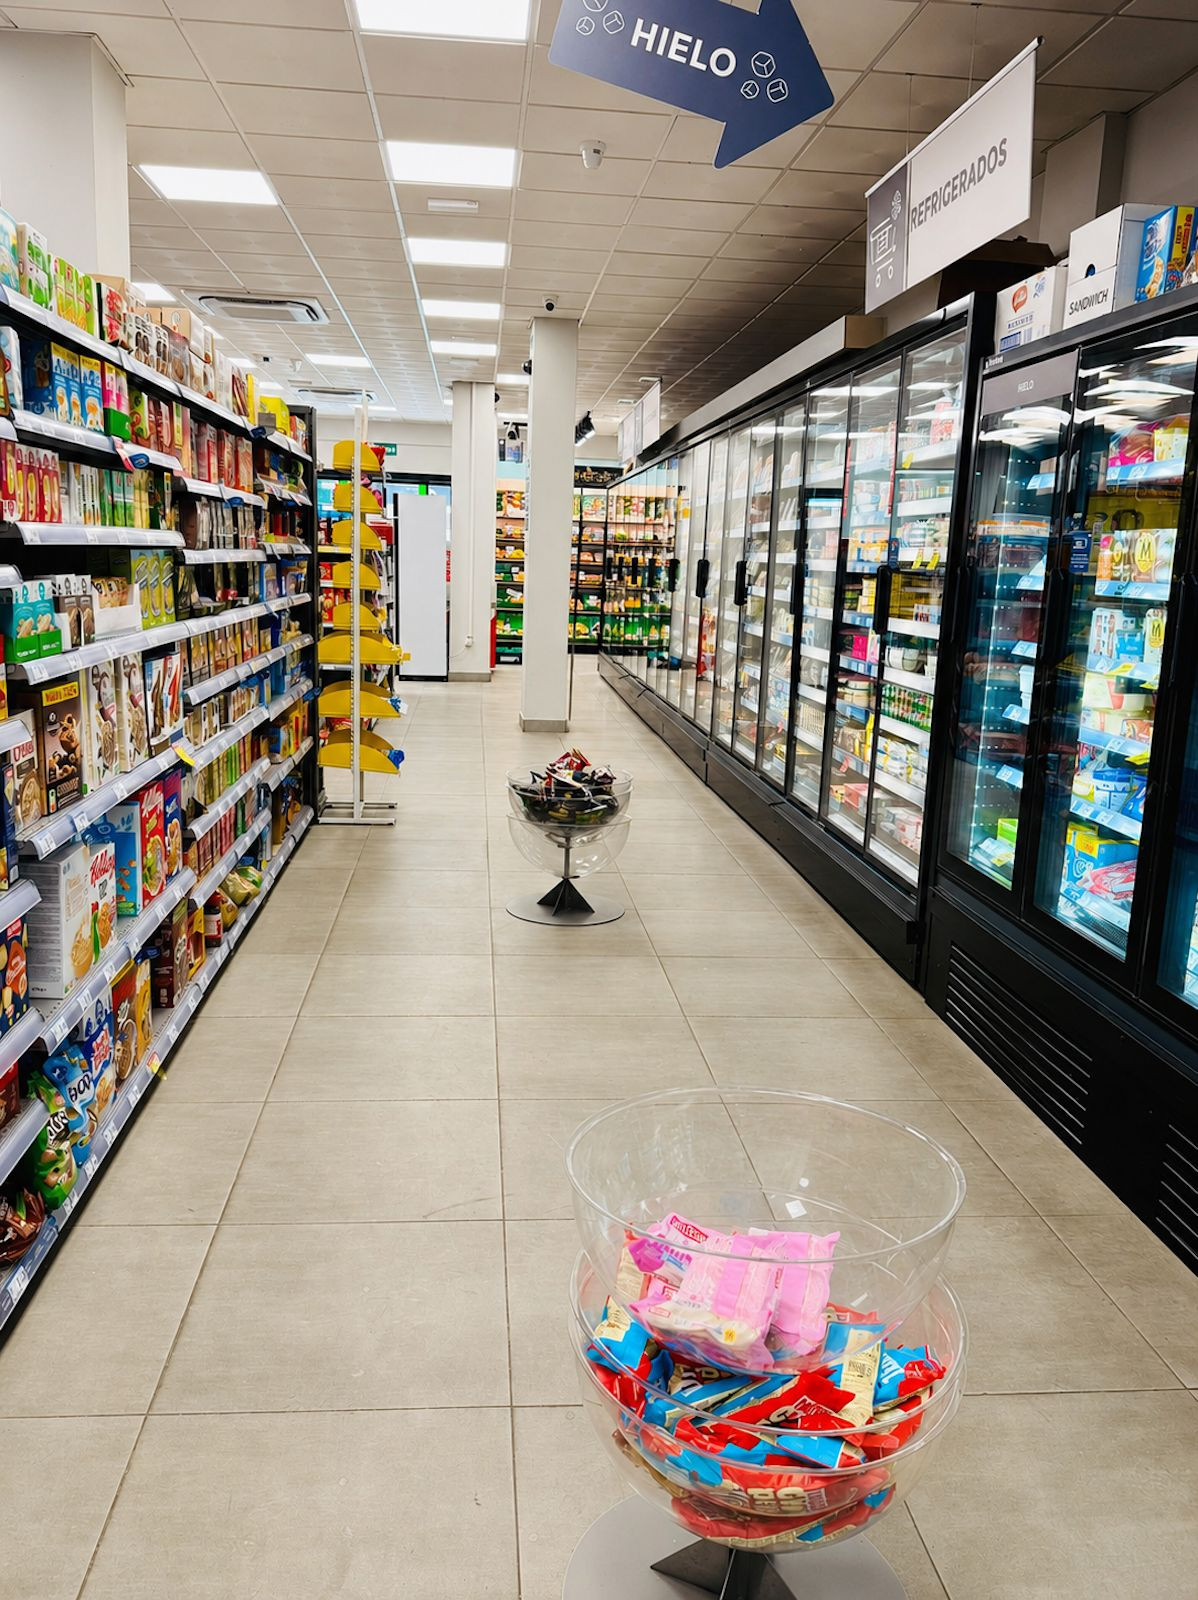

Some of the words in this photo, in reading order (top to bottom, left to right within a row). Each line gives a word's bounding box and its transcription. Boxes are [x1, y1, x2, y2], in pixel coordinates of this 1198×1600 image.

[630, 17, 737, 78] HIELO
[910, 137, 1008, 233] REFRIGERADOS
[1068, 288, 1109, 316] SANDWICH
[1017, 379, 1034, 393] HIELO
